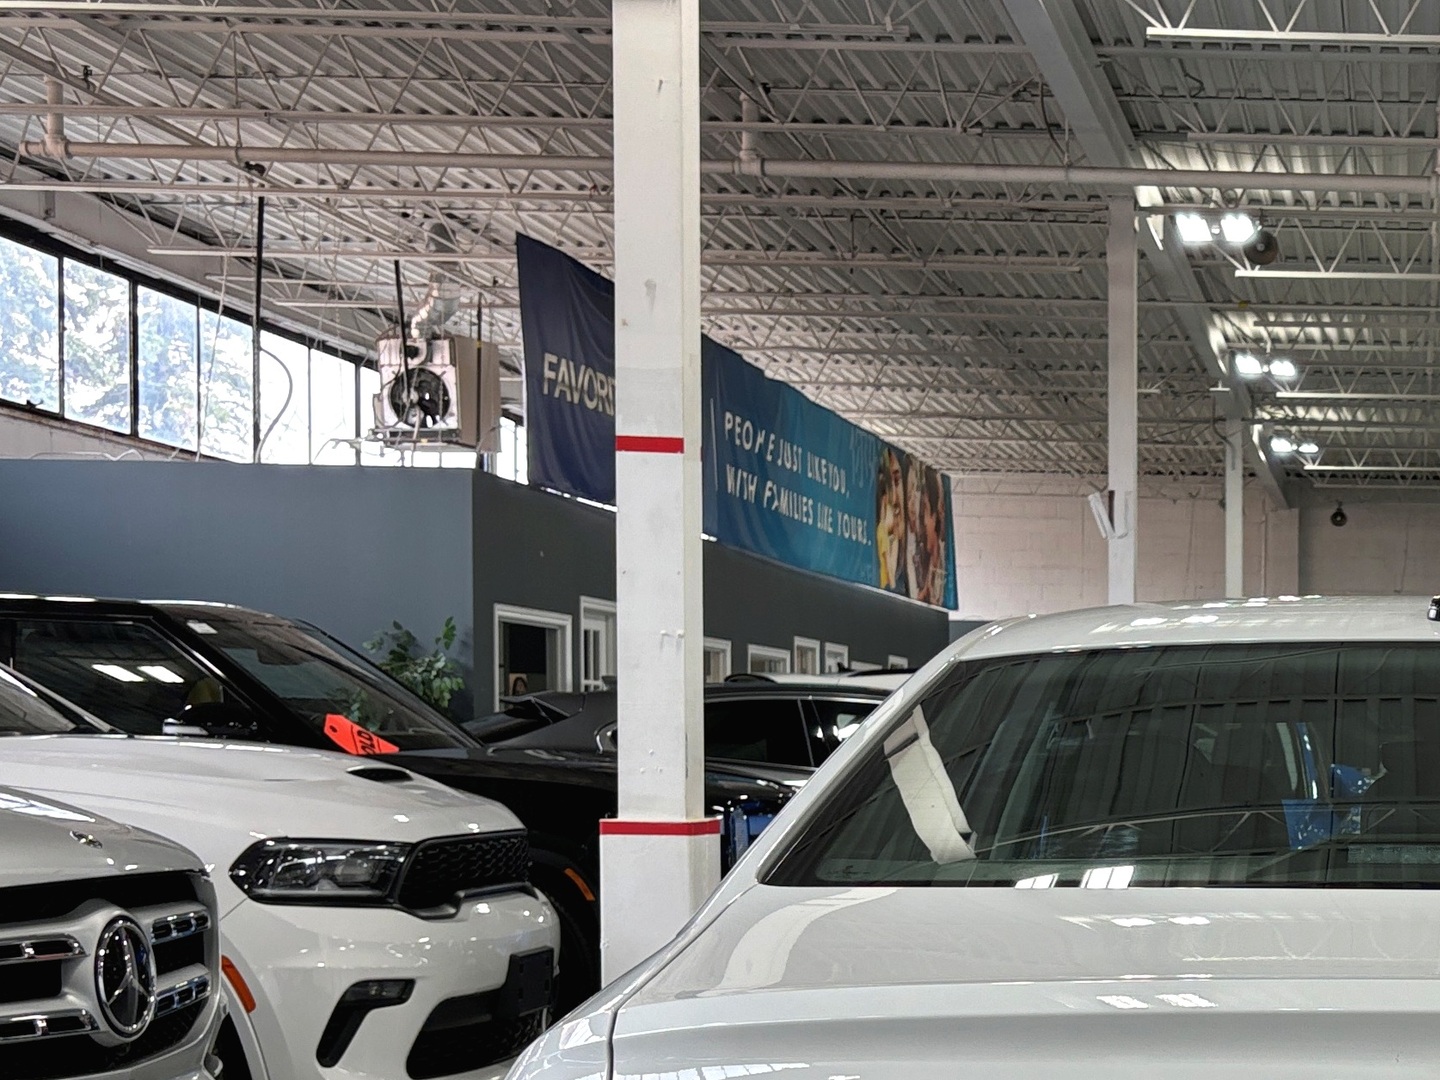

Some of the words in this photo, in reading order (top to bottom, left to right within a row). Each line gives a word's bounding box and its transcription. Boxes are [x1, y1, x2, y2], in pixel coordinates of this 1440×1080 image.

[543, 352, 615, 416] FAVORI
[777, 438, 803, 474] JUST
[807, 451, 827, 485] LIKE
[726, 464, 758, 504] WITH
[763, 480, 814, 526] FAMILIES
[817, 502, 833, 534] LIKE
